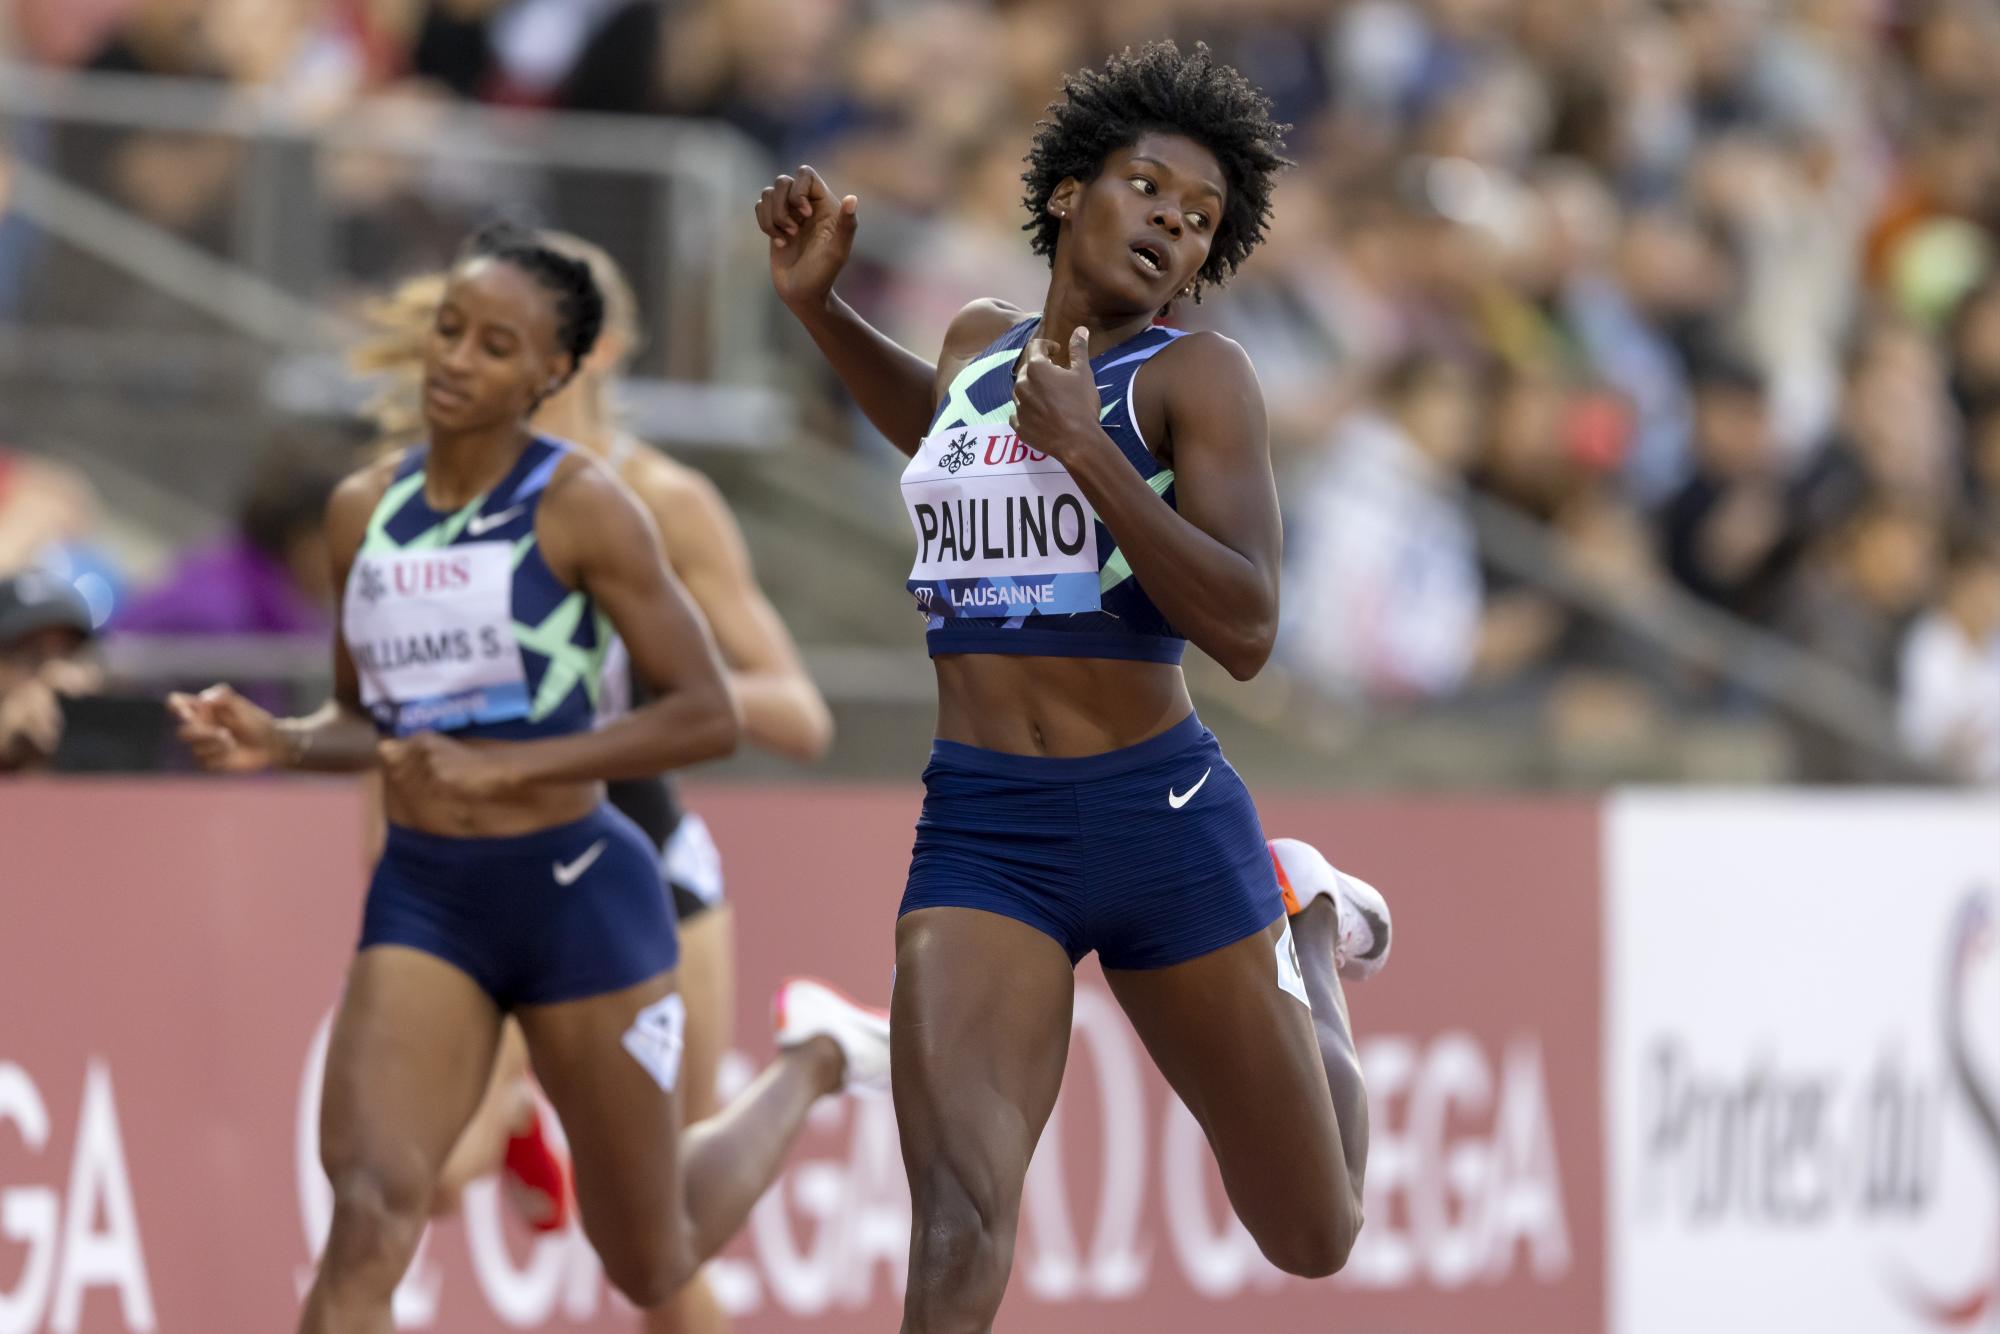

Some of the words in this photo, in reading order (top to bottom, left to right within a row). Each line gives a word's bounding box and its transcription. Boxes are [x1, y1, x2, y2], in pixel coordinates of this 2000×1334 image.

[914, 493, 1087, 564] PAULINO
[393, 556, 471, 596] UBS
[951, 584, 1056, 607] LAUSANNE
